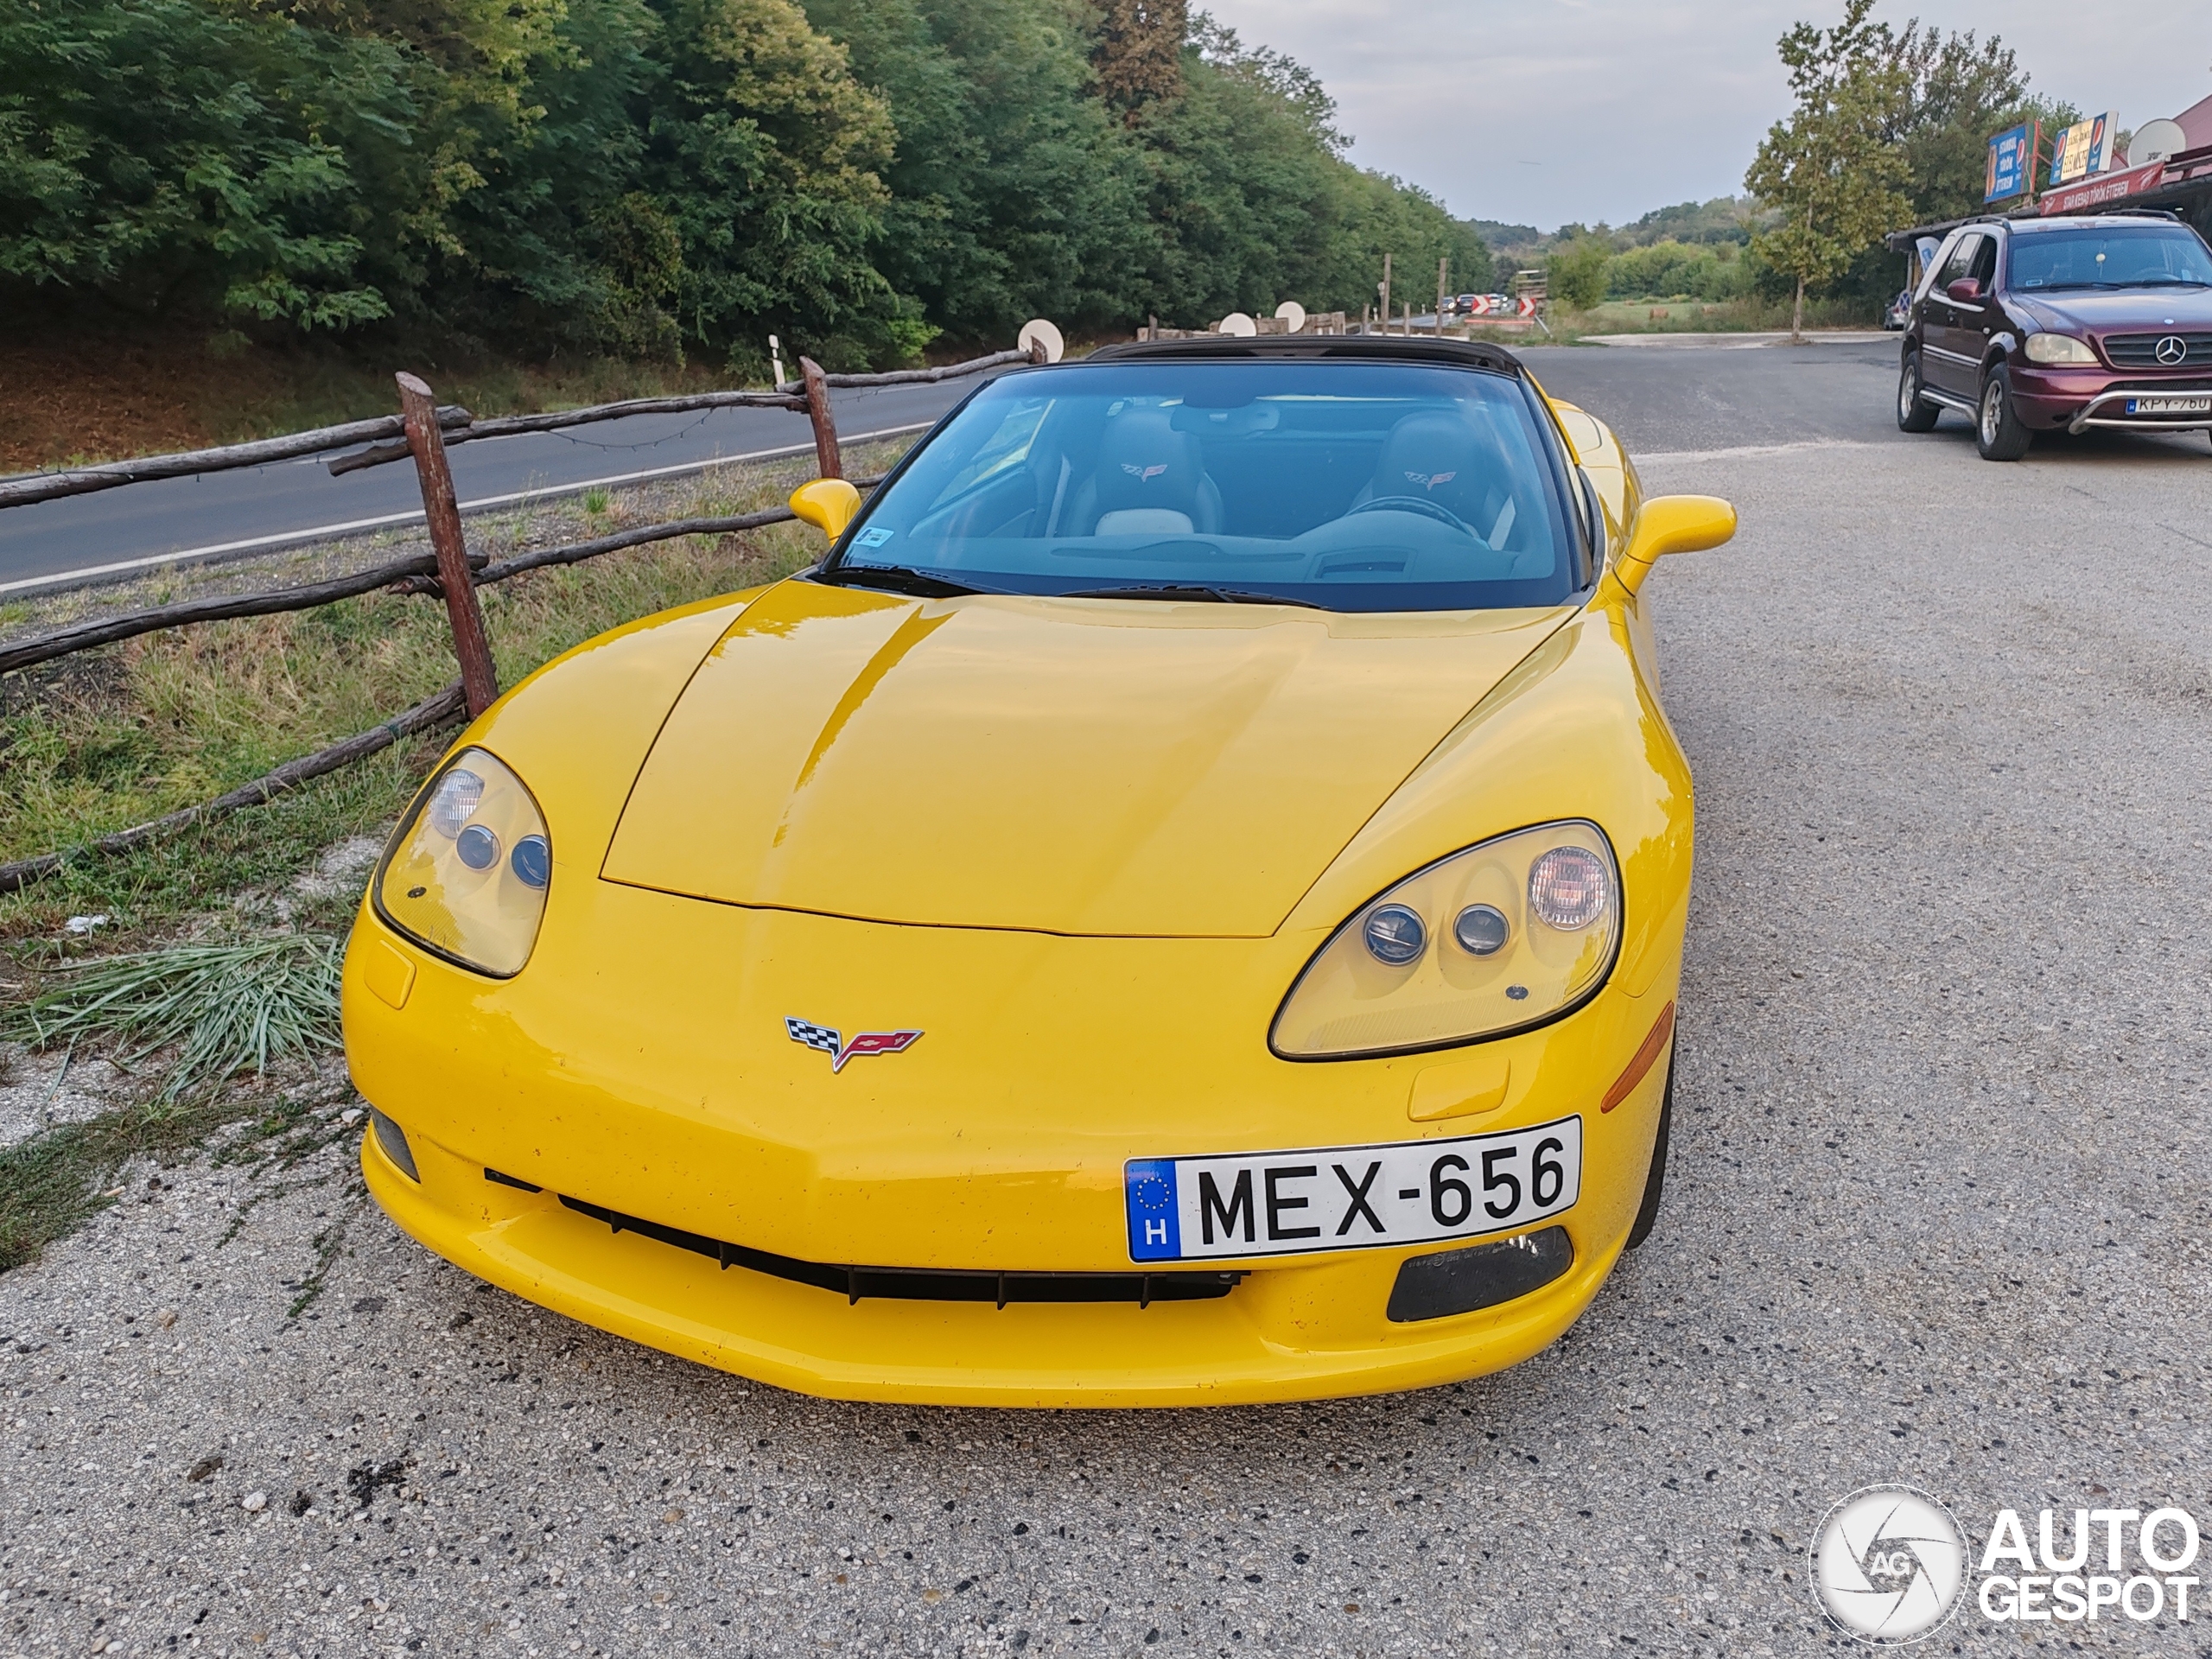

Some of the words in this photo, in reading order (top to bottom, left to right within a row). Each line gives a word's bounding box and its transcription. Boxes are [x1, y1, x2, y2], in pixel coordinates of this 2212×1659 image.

[2090, 185, 2107, 204] TÖRÖK
[2106, 181, 2129, 200] ÉTTEREM
[1198, 1137, 1564, 1245] MEX-656
[1145, 1218, 1167, 1245] H
